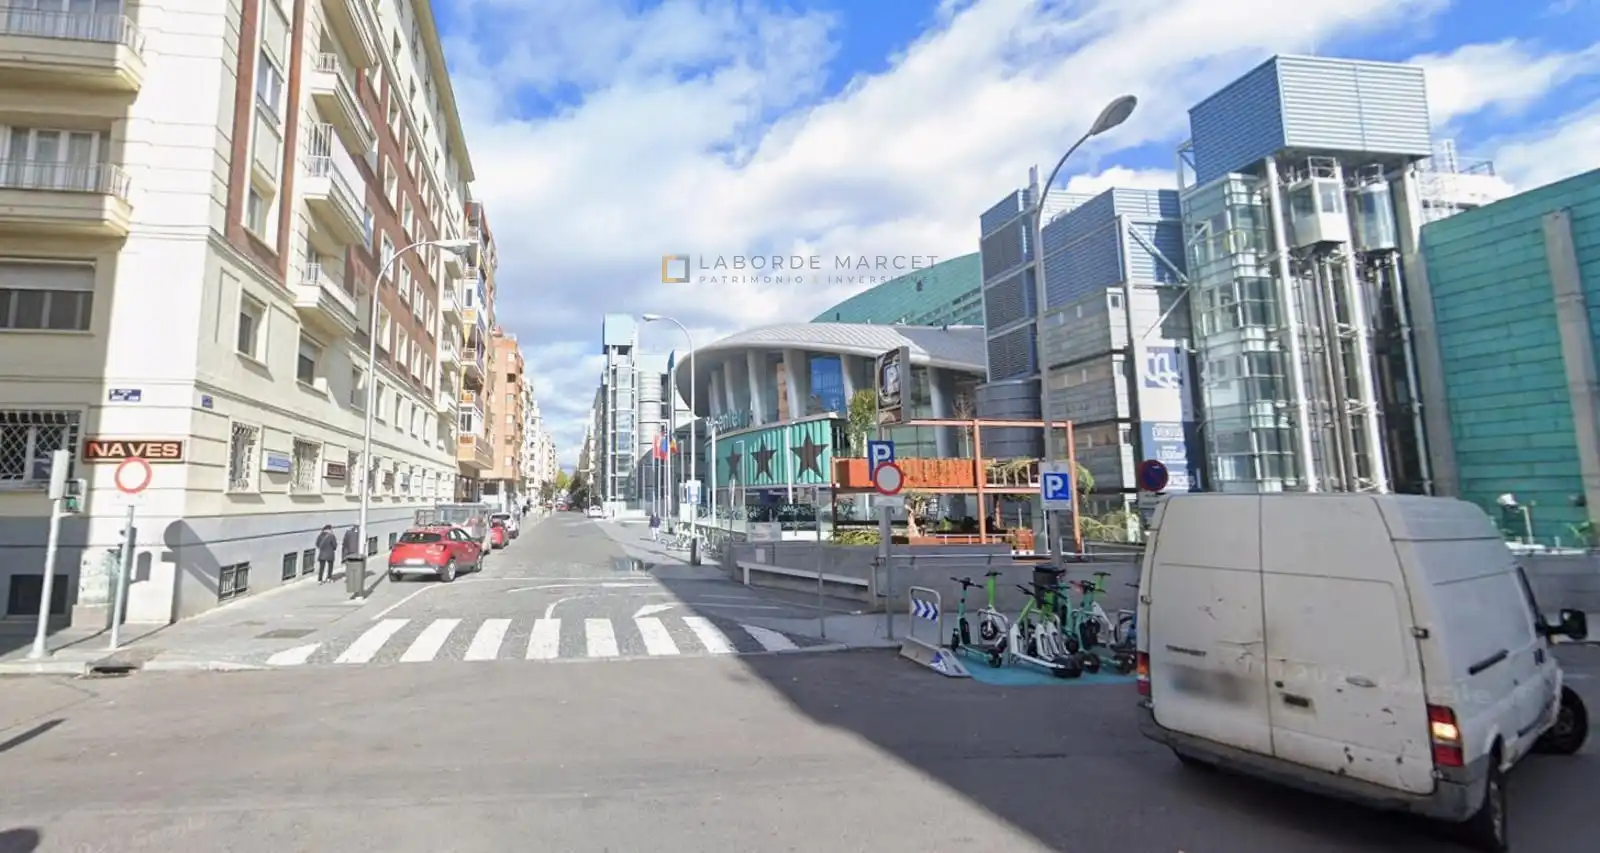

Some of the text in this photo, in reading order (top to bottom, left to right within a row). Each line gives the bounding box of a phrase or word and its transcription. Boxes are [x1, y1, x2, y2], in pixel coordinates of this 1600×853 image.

[88, 442, 179, 457] NAVES
[872, 444, 891, 470] P
[1046, 475, 1064, 499] P
